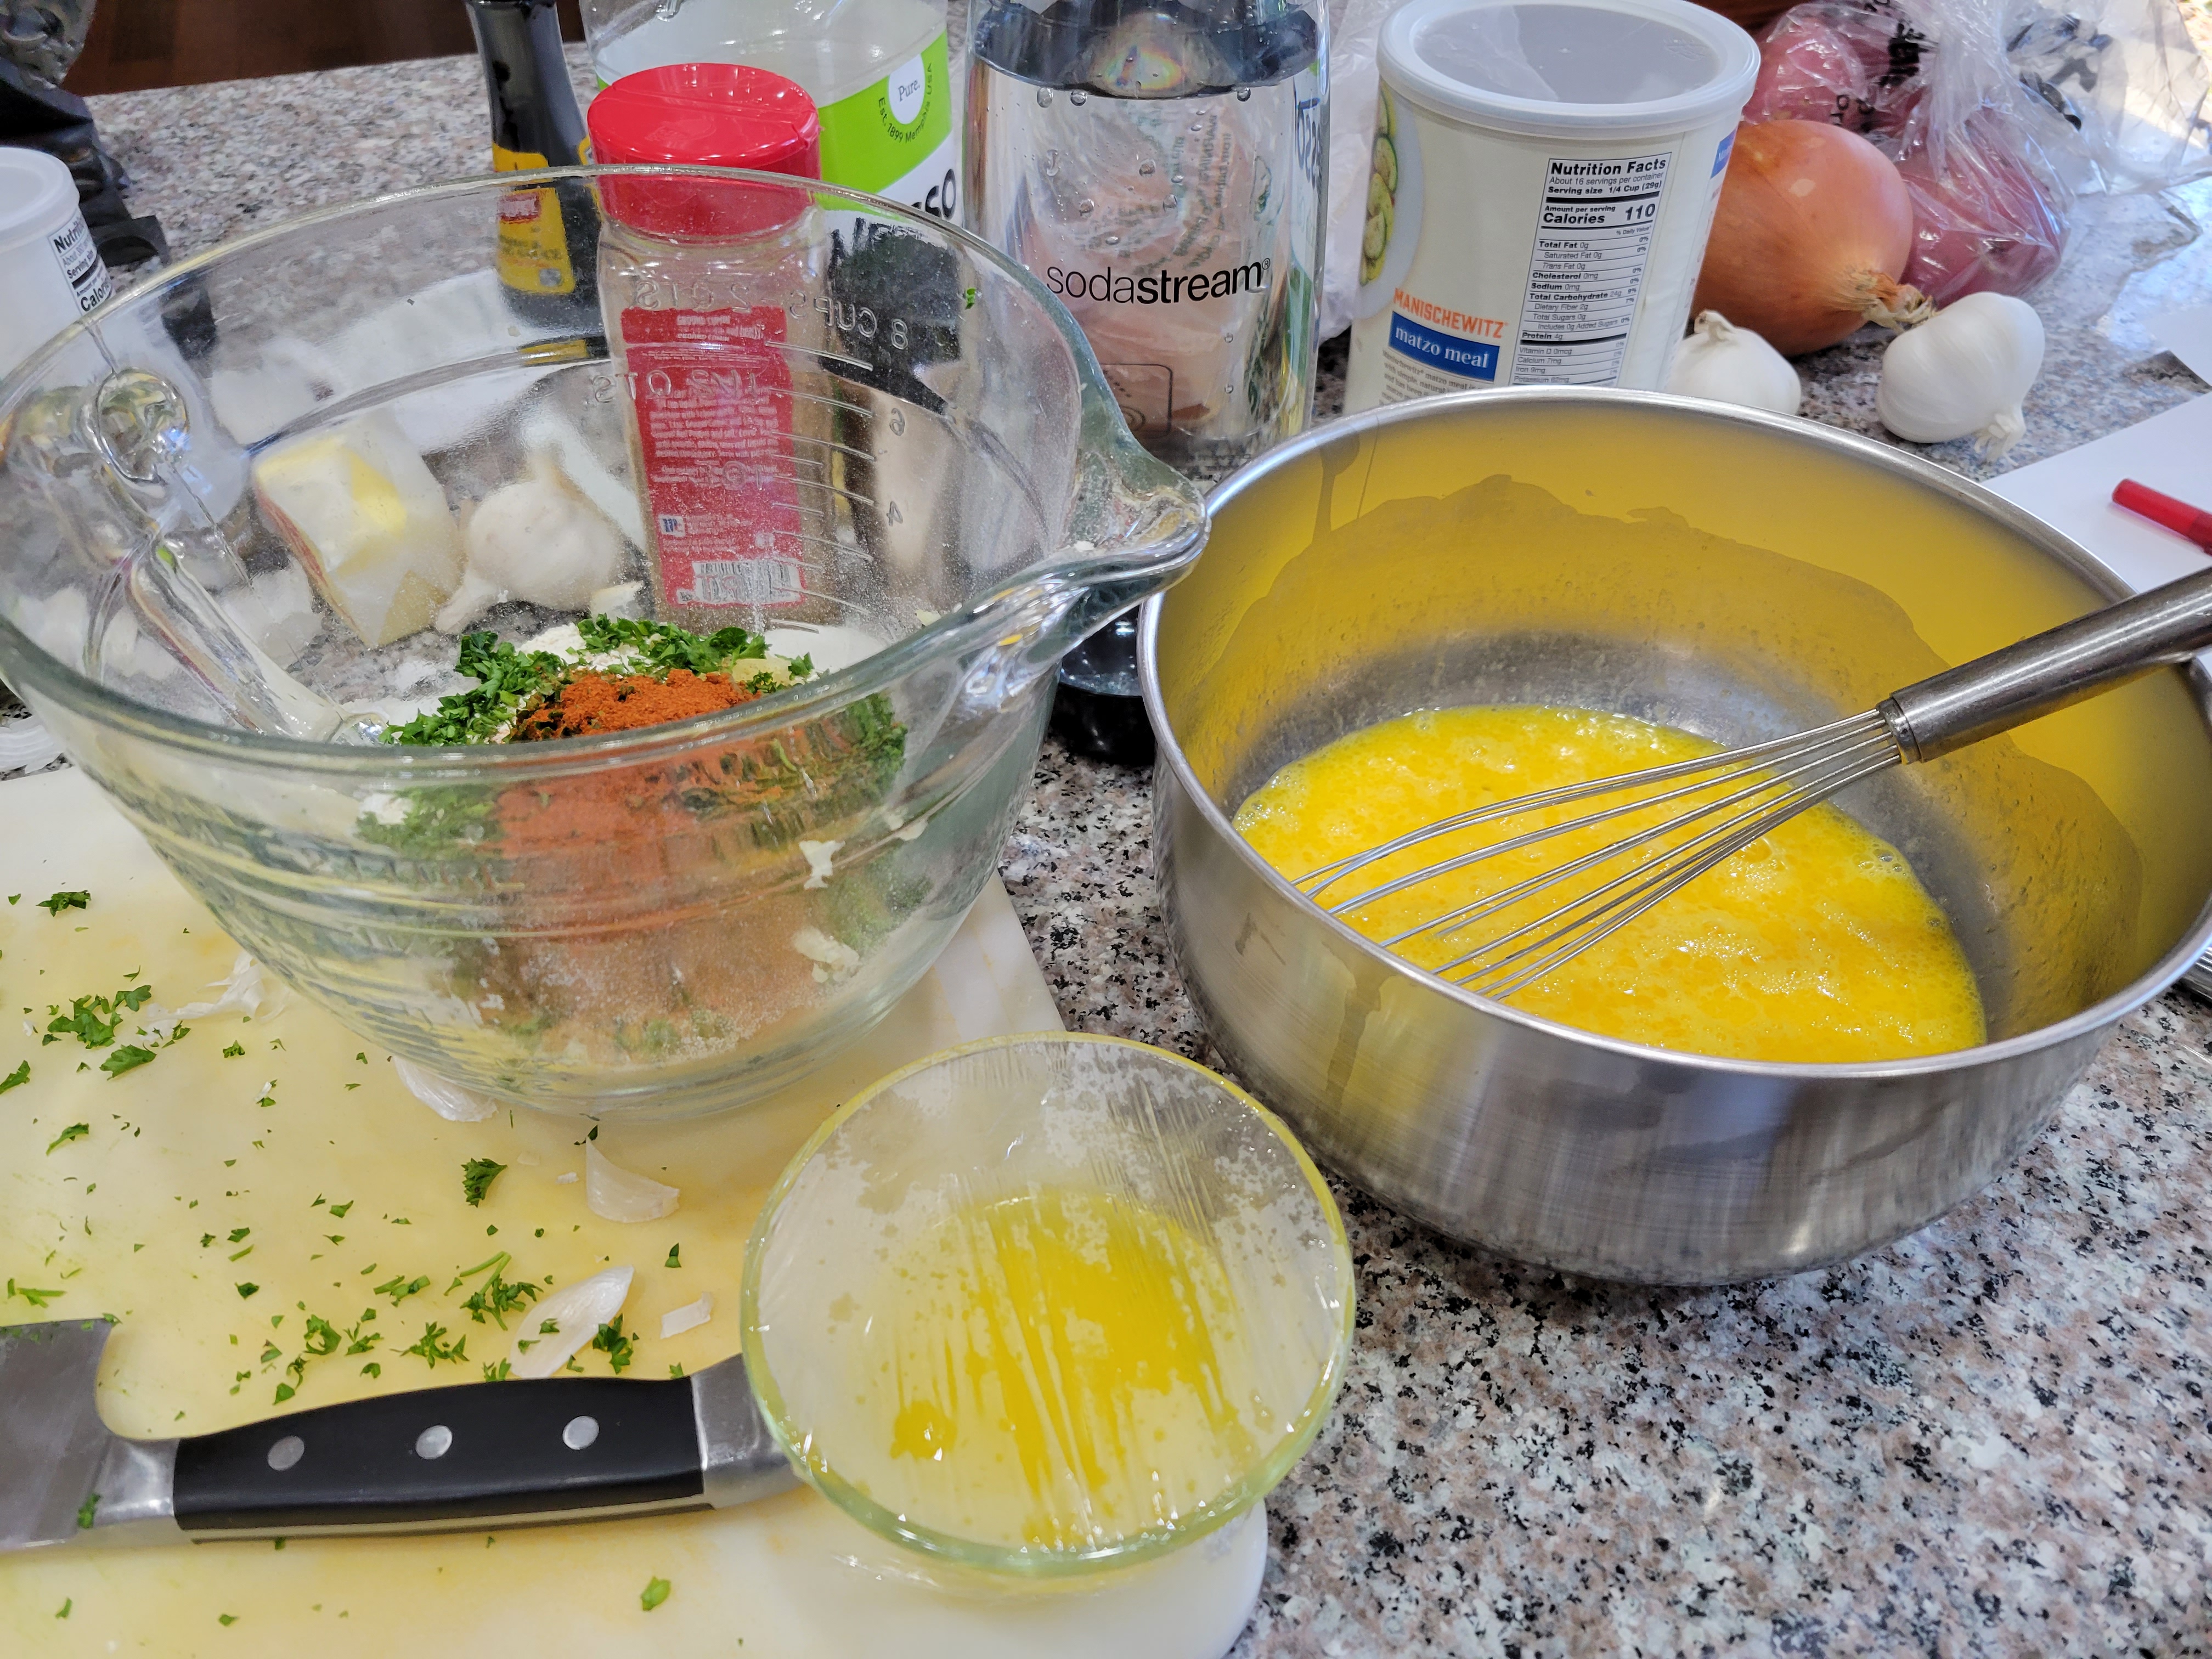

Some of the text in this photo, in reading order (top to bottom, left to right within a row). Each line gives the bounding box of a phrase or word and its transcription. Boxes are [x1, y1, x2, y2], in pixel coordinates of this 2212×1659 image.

[898, 80, 920, 102] Pure.
[887, 123, 903, 143] 1899
[1550, 158, 1666, 176] Nutrition Facts
[1549, 176, 1572, 185] About
[1585, 177, 1617, 185] servings
[1618, 176, 1631, 185] per
[1633, 171, 1664, 182] container
[1548, 186, 1582, 195] Serving
[1641, 180, 1662, 191] (29g)
[1543, 203, 1656, 224] Calories 110
[1554, 292, 1608, 301] Carbohydrate
[1598, 319, 1618, 328] Sugars
[1395, 327, 1489, 368] matzo meal
